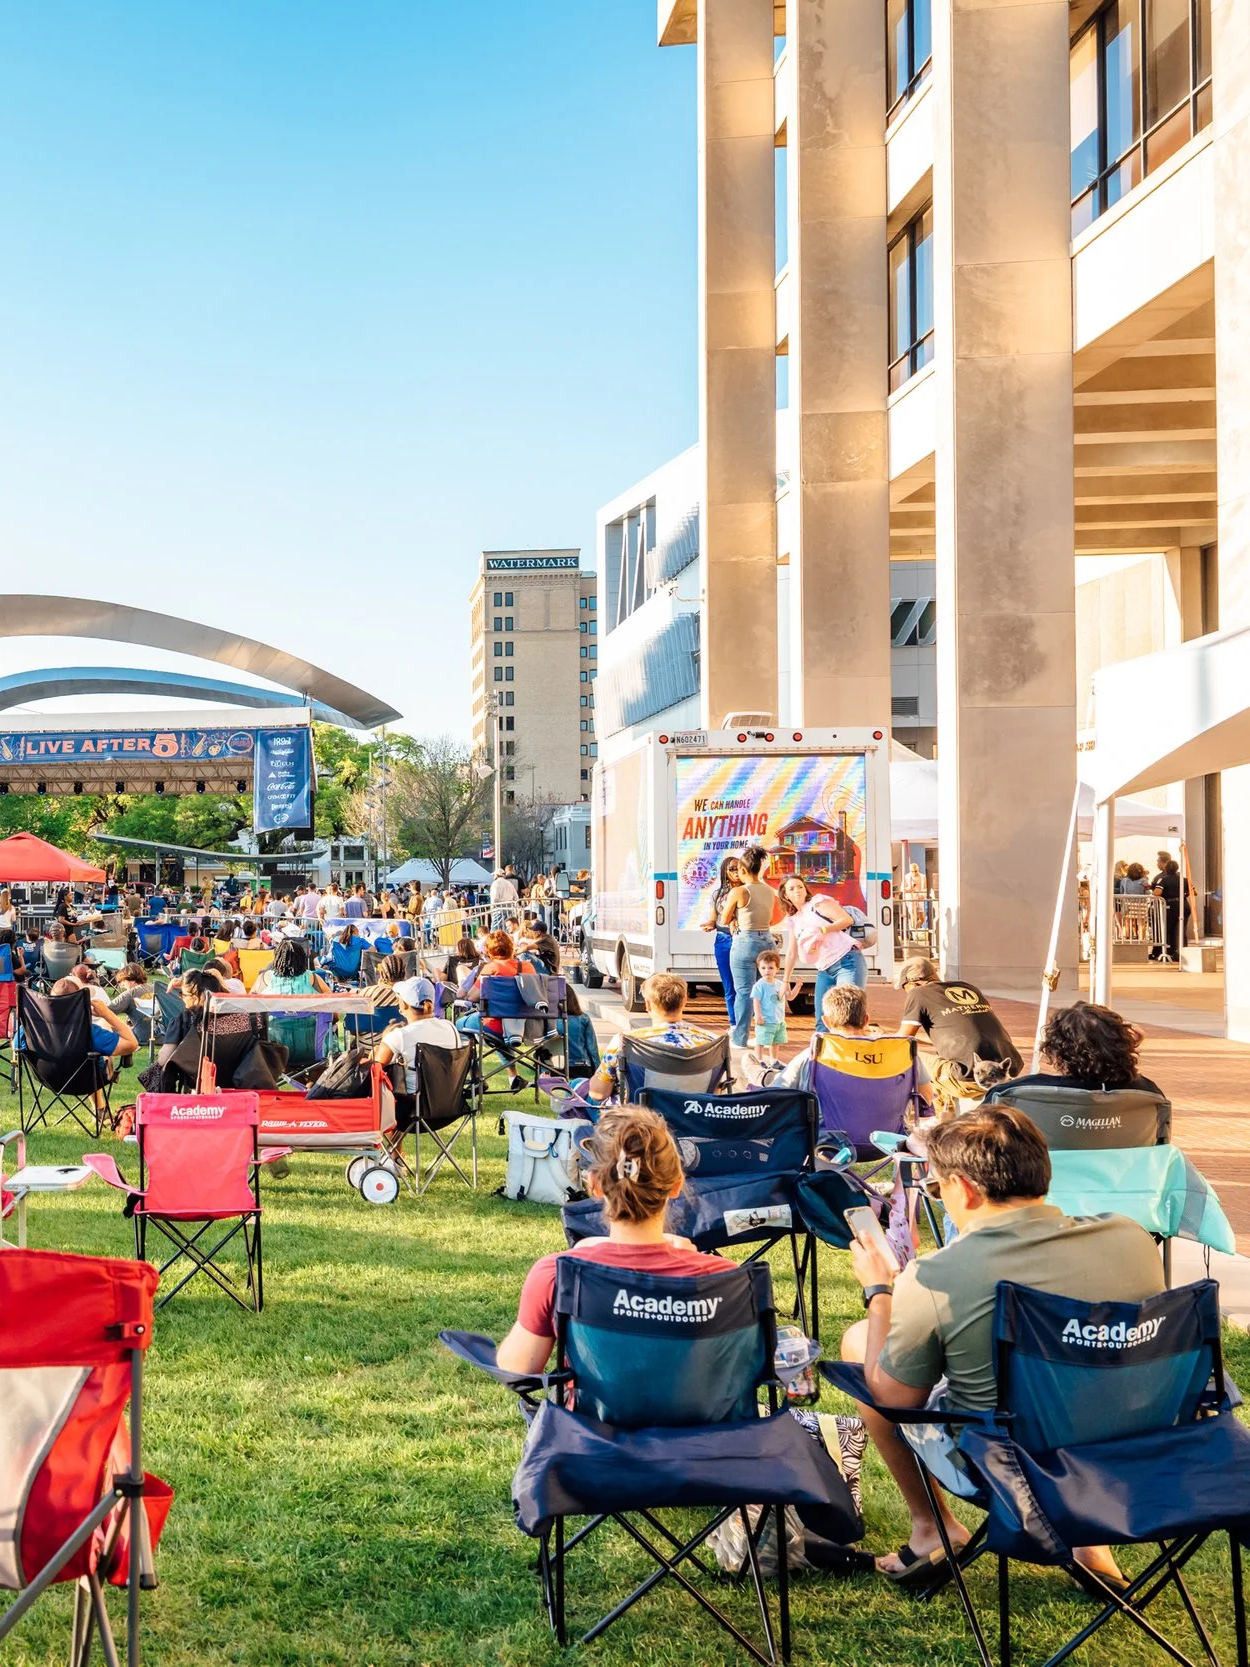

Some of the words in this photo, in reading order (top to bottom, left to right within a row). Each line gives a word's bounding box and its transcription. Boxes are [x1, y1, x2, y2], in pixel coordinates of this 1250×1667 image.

[488, 557, 577, 569] WATERMARK
[26, 740, 75, 755] LIVE
[80, 738, 150, 753] AFTER
[152, 733, 179, 757] 5
[694, 799, 709, 812] WE
[710, 801, 725, 811] CAN
[725, 799, 751, 809] HANDLE
[682, 813, 769, 839] ANYTHING
[703, 842, 712, 851] IN
[712, 842, 729, 850] YOUR
[855, 1051, 884, 1065] LSU
[170, 1104, 225, 1118] Academy
[704, 1102, 768, 1115] Academy
[1076, 1116, 1121, 1126] MAGELLAN
[613, 1289, 719, 1320] Academy
[1062, 1317, 1163, 1342] Academy
